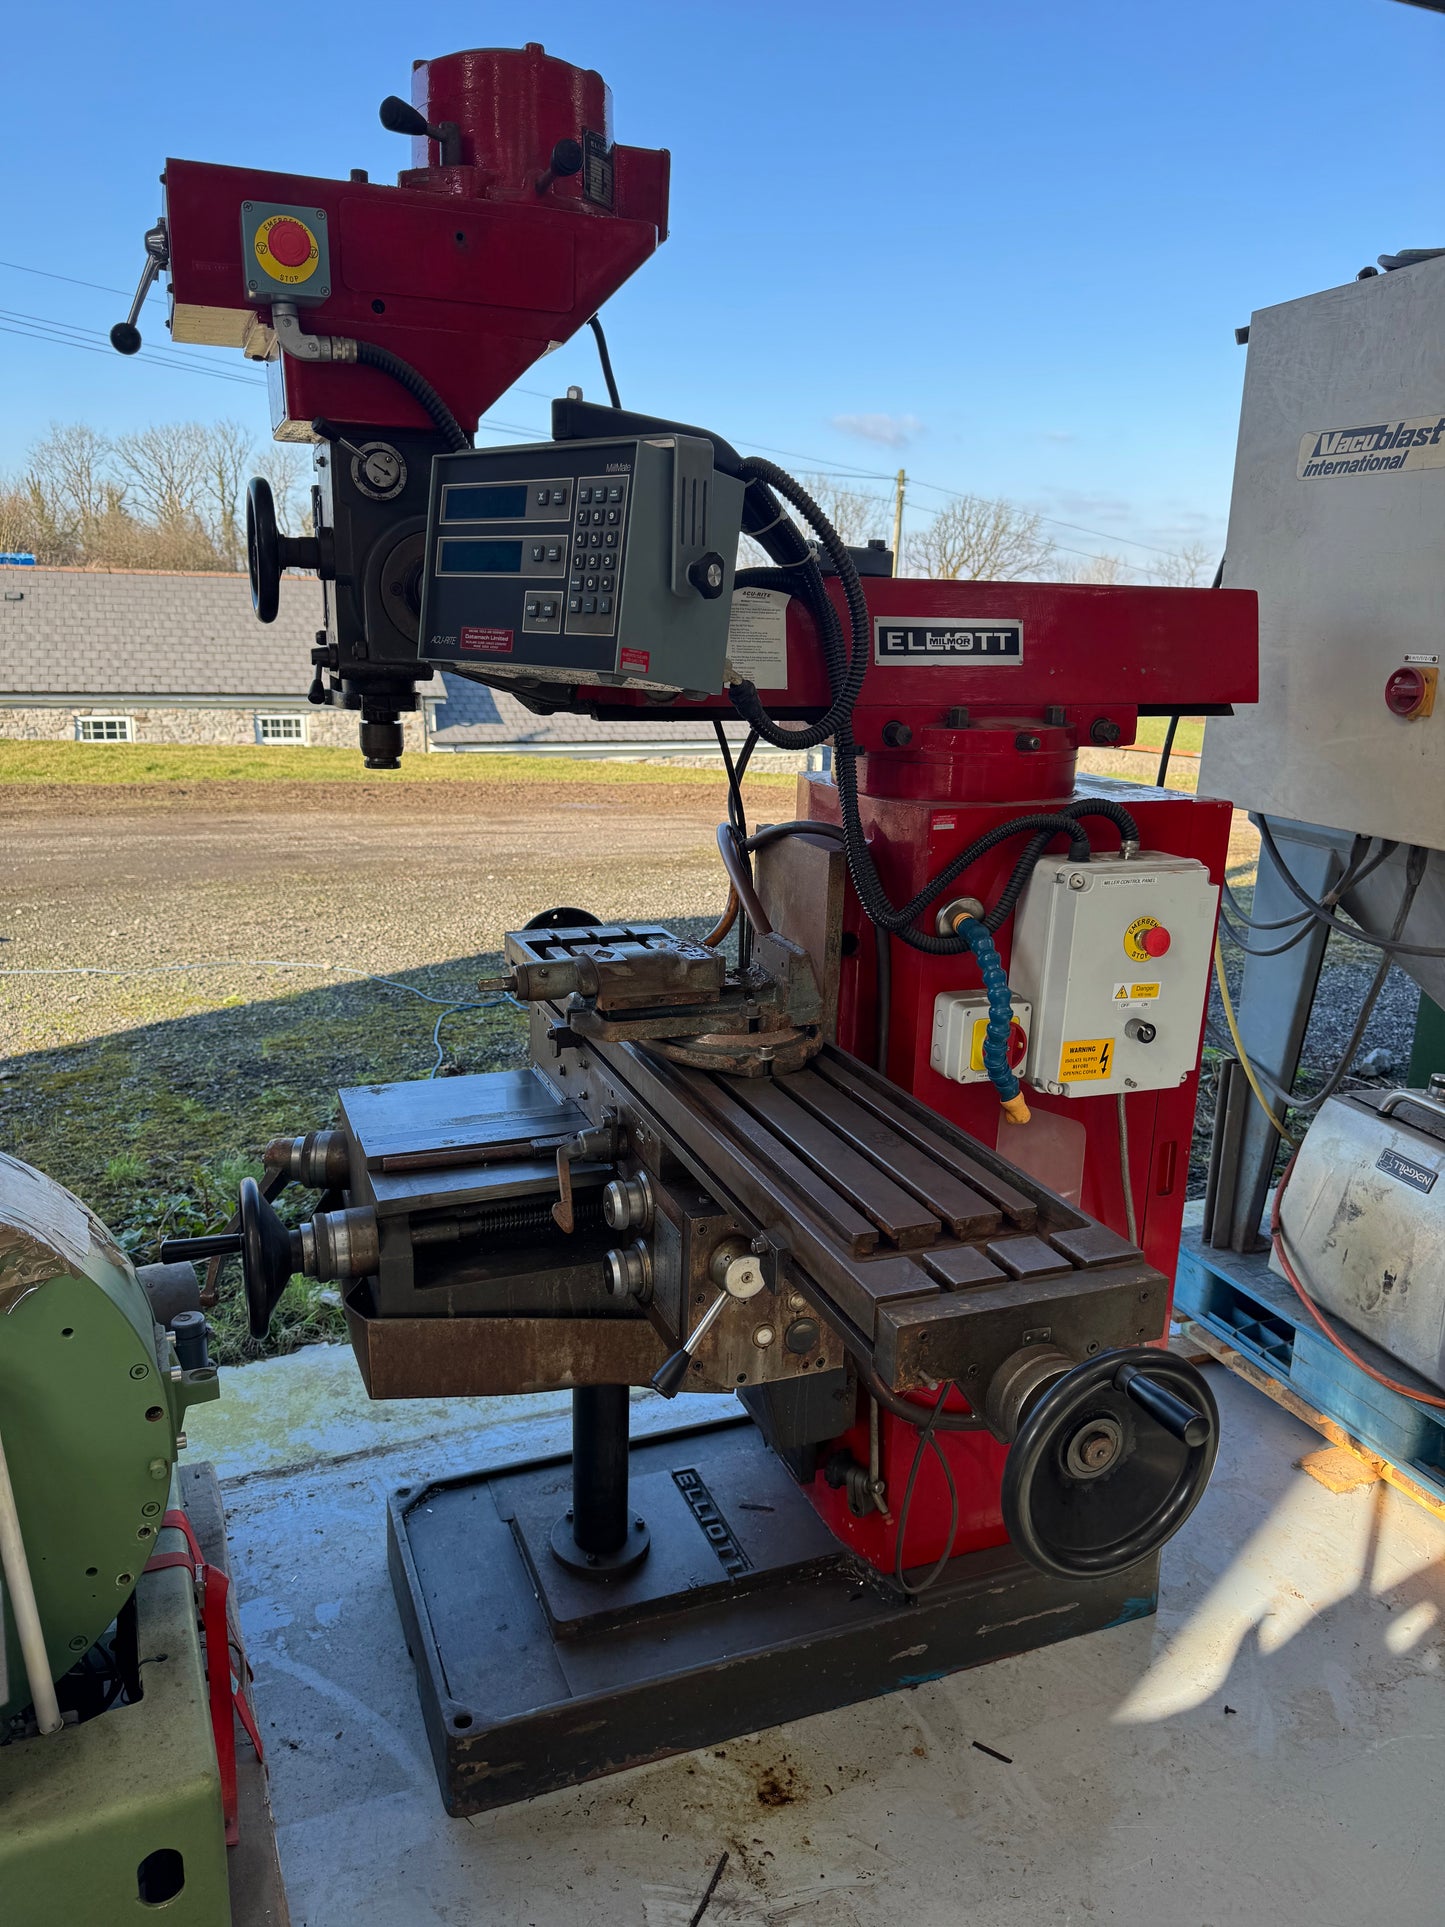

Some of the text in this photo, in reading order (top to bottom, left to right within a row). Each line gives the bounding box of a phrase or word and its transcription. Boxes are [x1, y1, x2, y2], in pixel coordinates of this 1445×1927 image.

[279, 273, 299, 283] STOP
[606, 463, 632, 472] MillMate
[1302, 450, 1410, 478] international
[578, 512, 615, 521] 7 8 9
[576, 535, 582, 543] 4
[591, 535, 597, 543] 5
[589, 557, 595, 565] 2
[604, 557, 610, 565] 3
[587, 579, 593, 587] 0
[431, 635, 457, 646] ACU-RITE
[929, 637, 971, 646] MILMOR
[1128, 918, 1159, 935] EMERGEN
[675, 1472, 749, 1573] ELLIOTT
